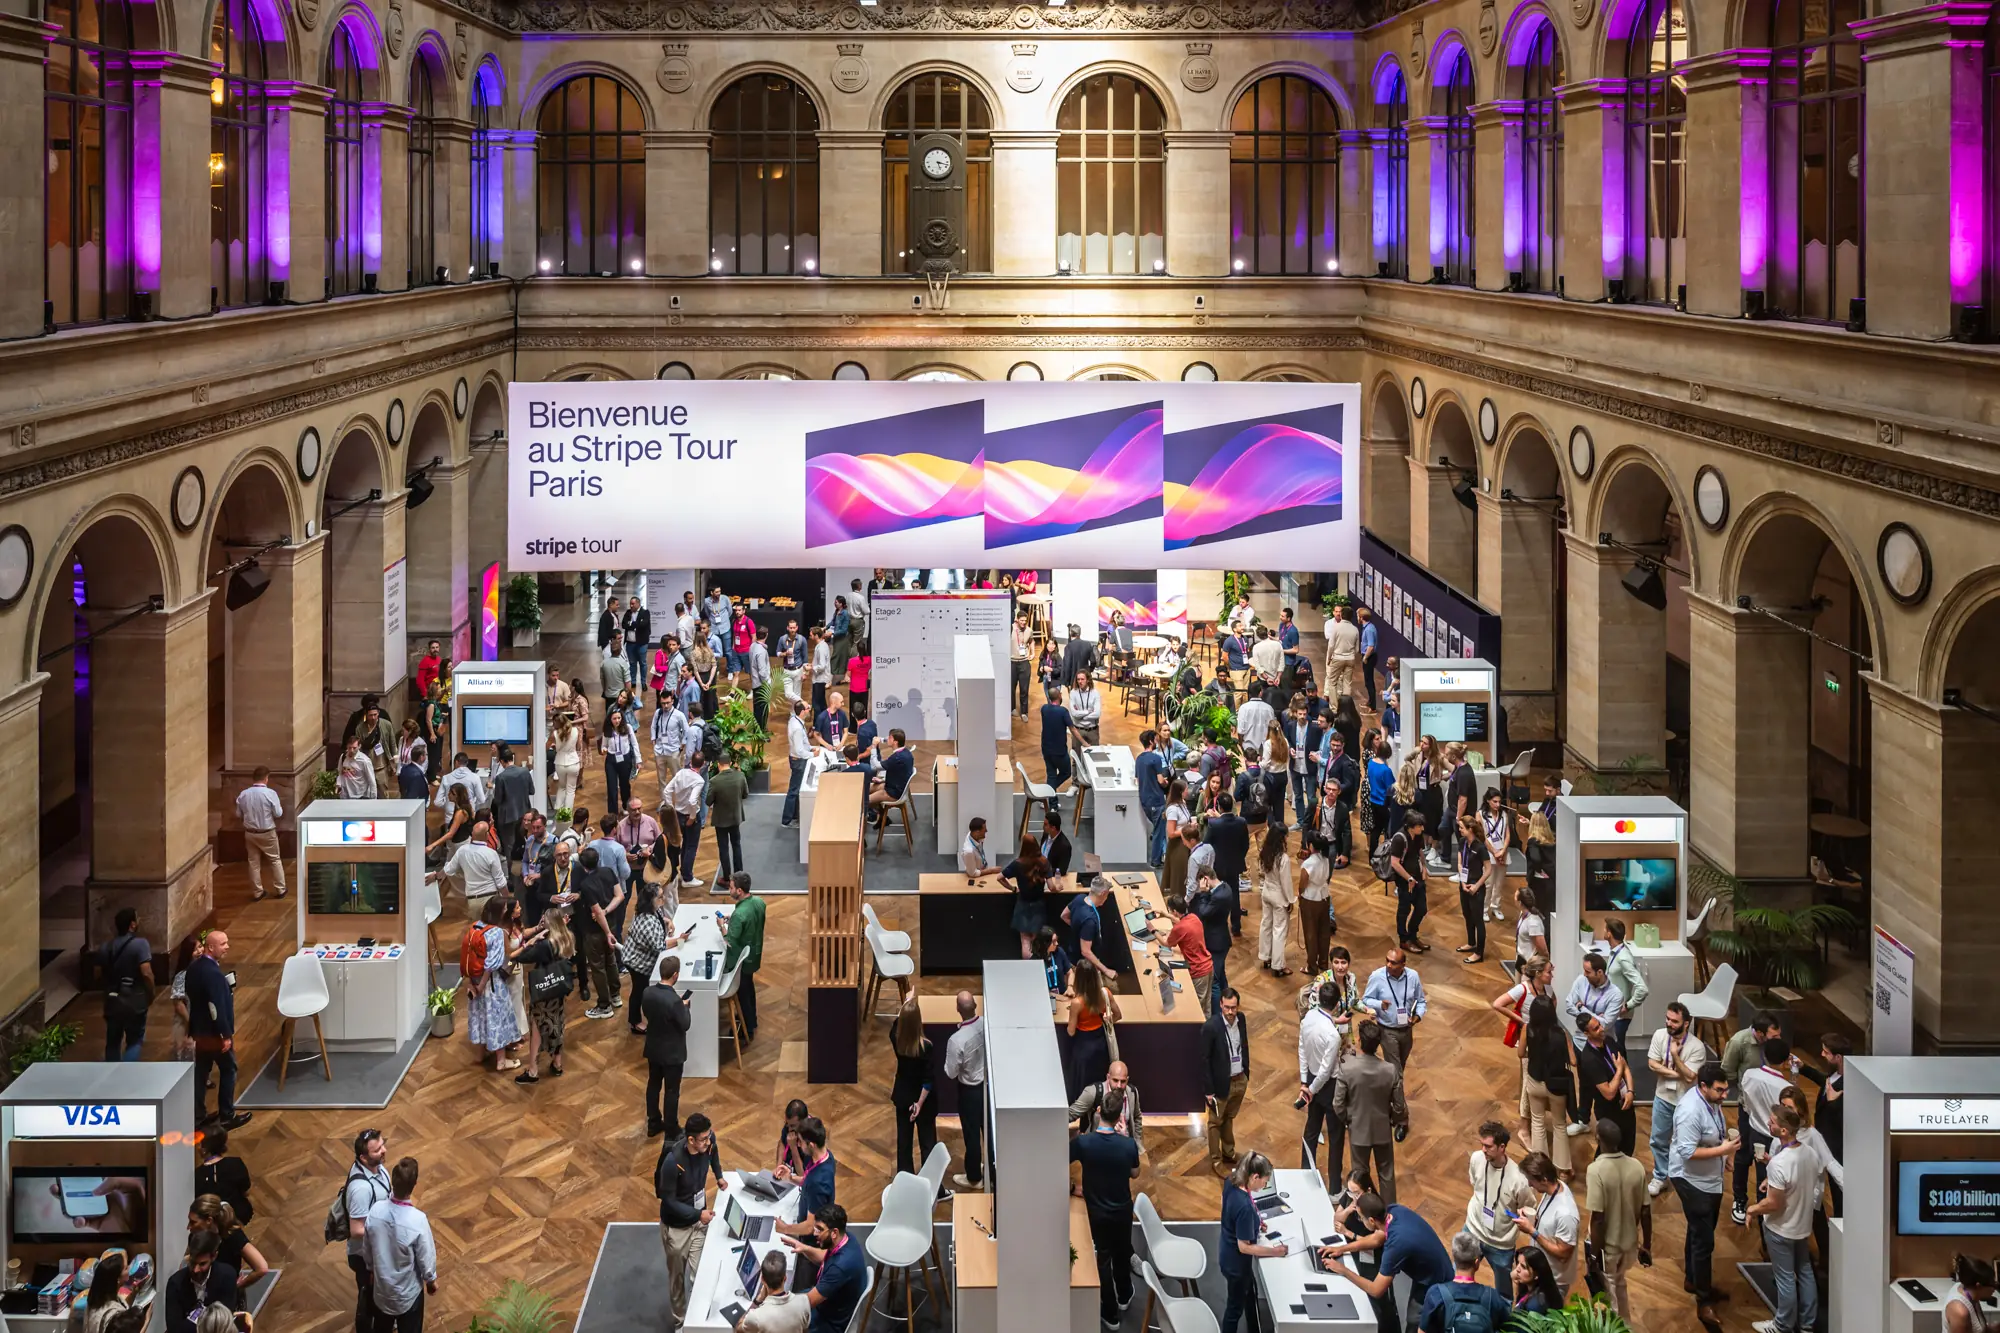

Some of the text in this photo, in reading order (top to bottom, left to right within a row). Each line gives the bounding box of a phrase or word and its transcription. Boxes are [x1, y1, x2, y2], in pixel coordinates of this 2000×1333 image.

[529, 401, 688, 428] Bienvenue
[528, 433, 738, 467] au Stripe Tour
[529, 470, 603, 497] Paris
[526, 537, 622, 558] stripe tour
[875, 608, 896, 616] Etage
[876, 657, 895, 665] Etage
[535, 981, 550, 989] TOTE
[551, 975, 565, 984] BAG
[1891, 967, 1907, 985] Guest
[60, 1105, 121, 1125] VISA
[1919, 1115, 1989, 1124] TRUELAYER
[1929, 1189, 2000, 1208] $100 billion
